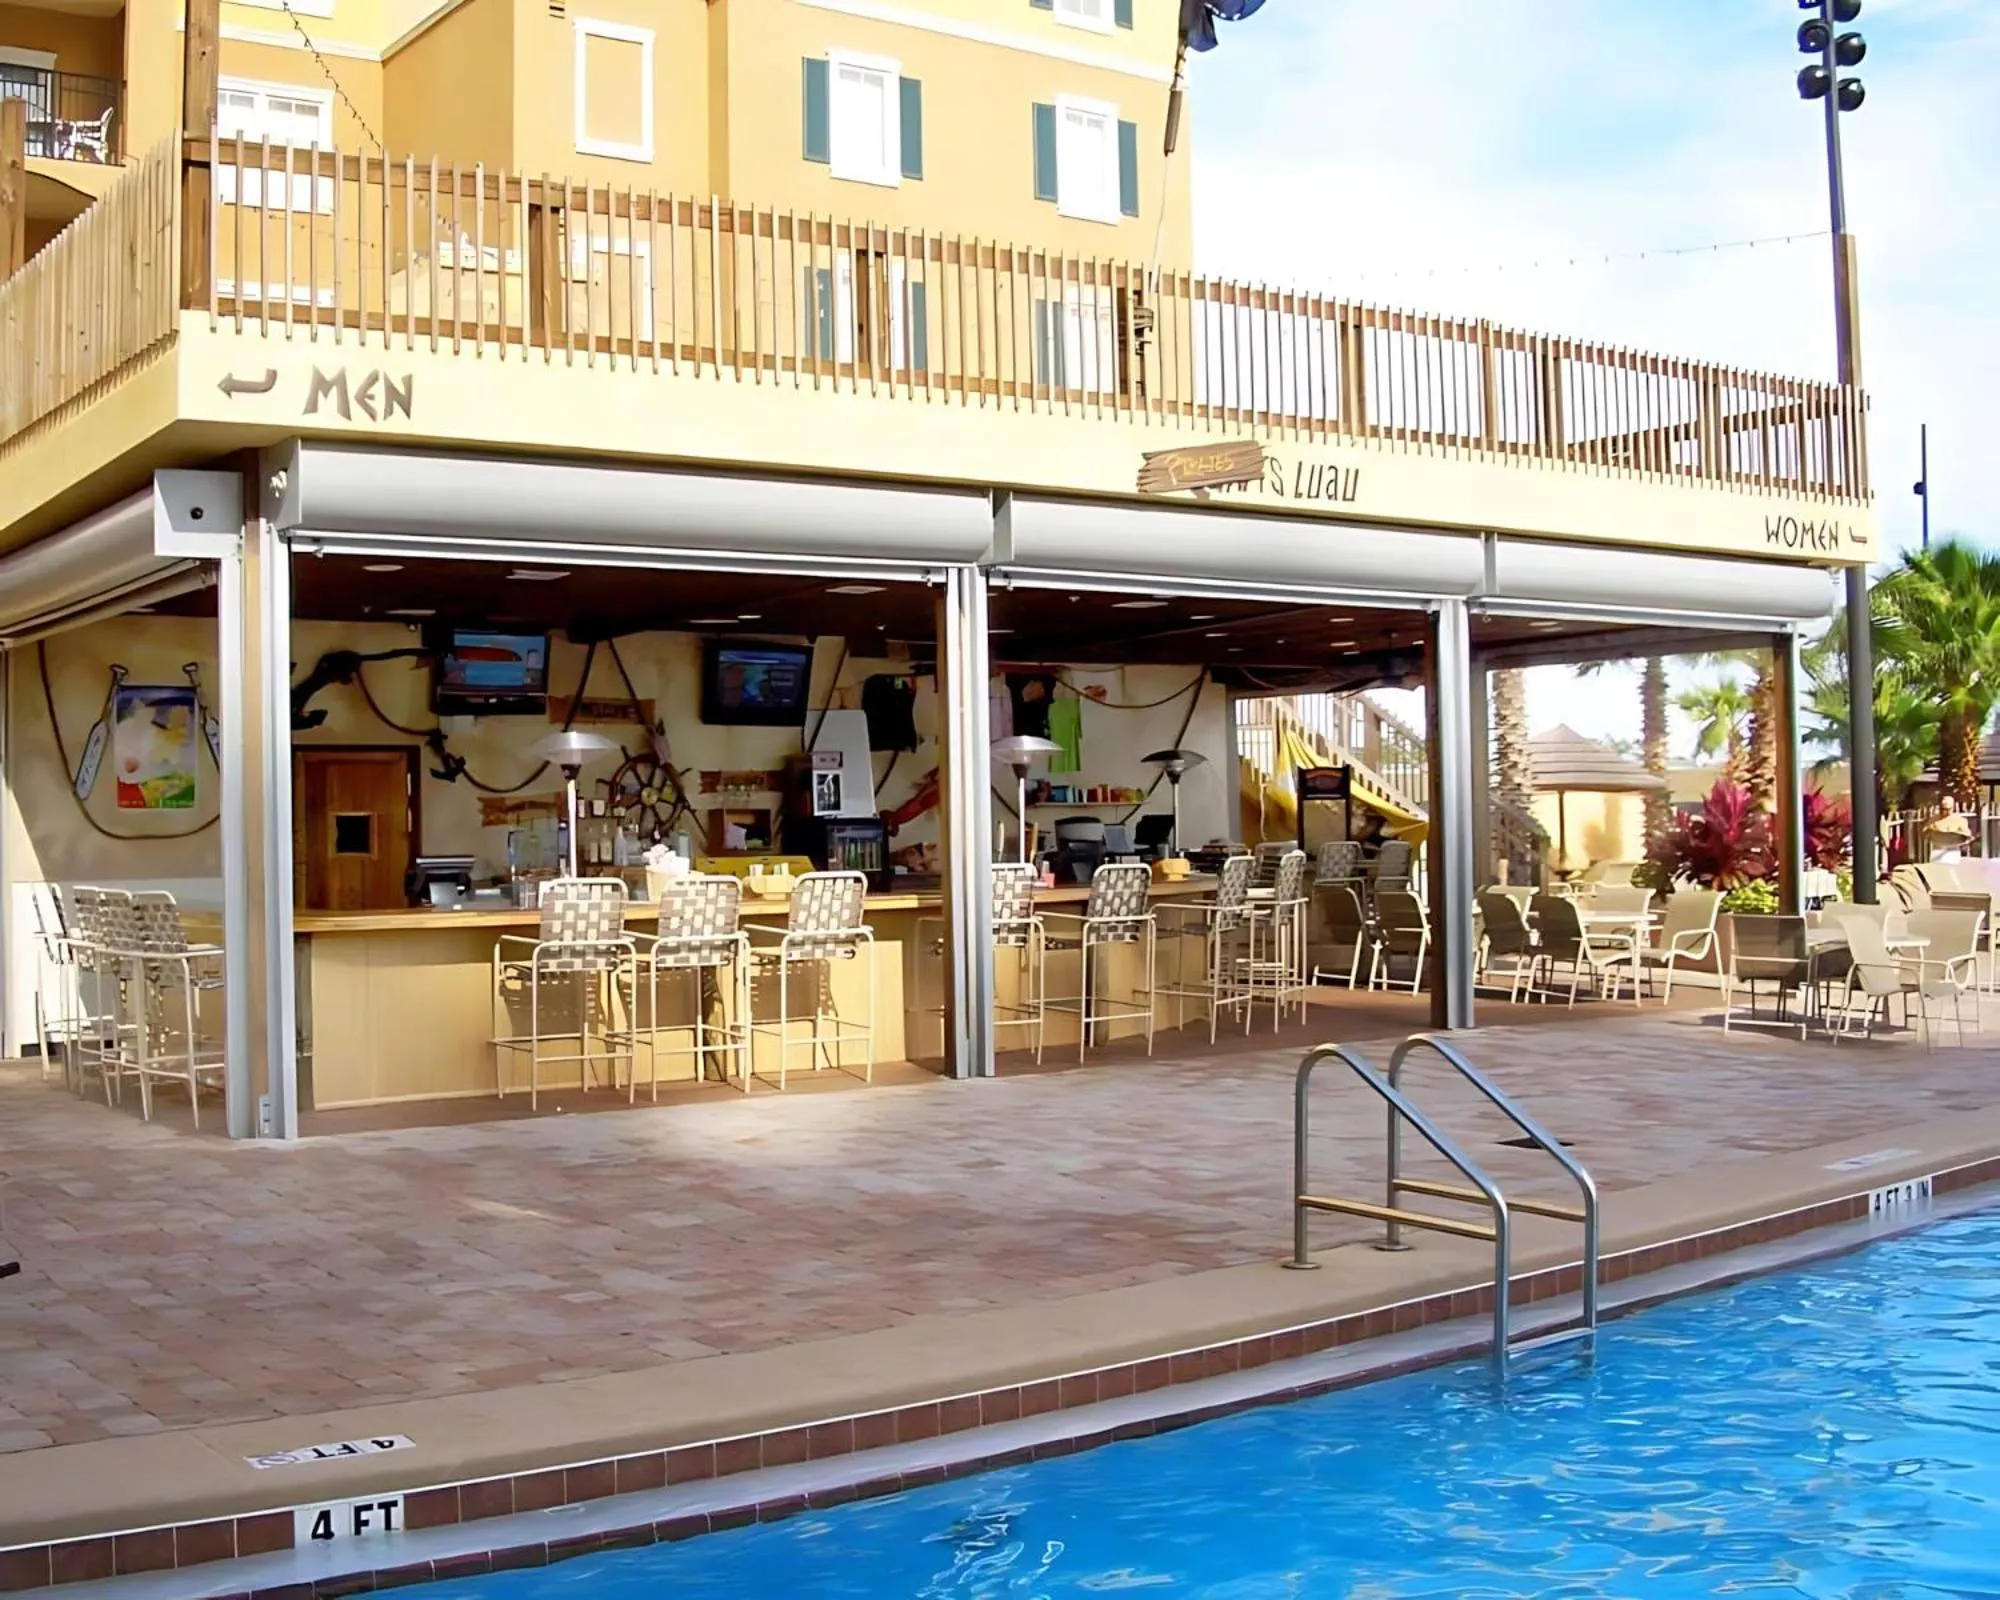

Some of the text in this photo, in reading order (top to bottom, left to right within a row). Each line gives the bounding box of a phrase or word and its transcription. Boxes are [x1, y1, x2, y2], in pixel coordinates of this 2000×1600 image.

[301, 364, 413, 422] MEN
[1765, 514, 1839, 551] WOMEN
[312, 1443, 358, 1460] FT
[311, 1499, 399, 1541] 4 FT
